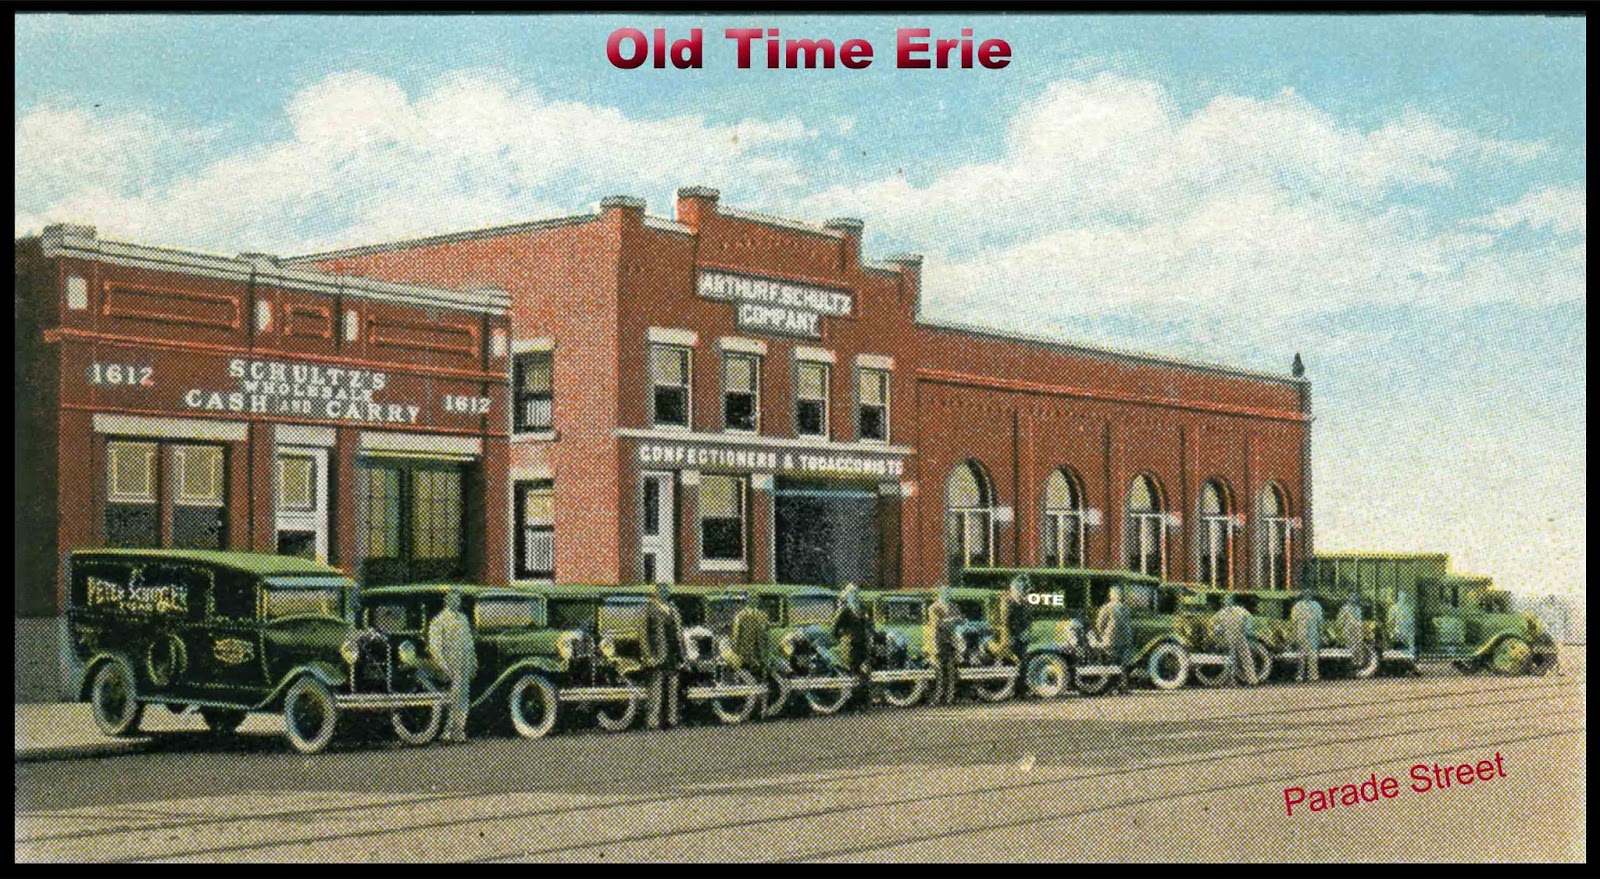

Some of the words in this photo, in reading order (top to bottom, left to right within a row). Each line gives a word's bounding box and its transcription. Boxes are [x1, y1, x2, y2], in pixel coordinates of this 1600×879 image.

[742, 305, 819, 336] COMPANY
[90, 363, 153, 386] 1612
[229, 358, 386, 391] SCHULTZ'S
[244, 381, 372, 402] WHOLESALE
[185, 389, 267, 413] CASH
[326, 400, 420, 423] CARRY
[444, 394, 491, 414] 1612
[639, 445, 776, 469] CONFECTIONERS
[782, 453, 794, 469] &
